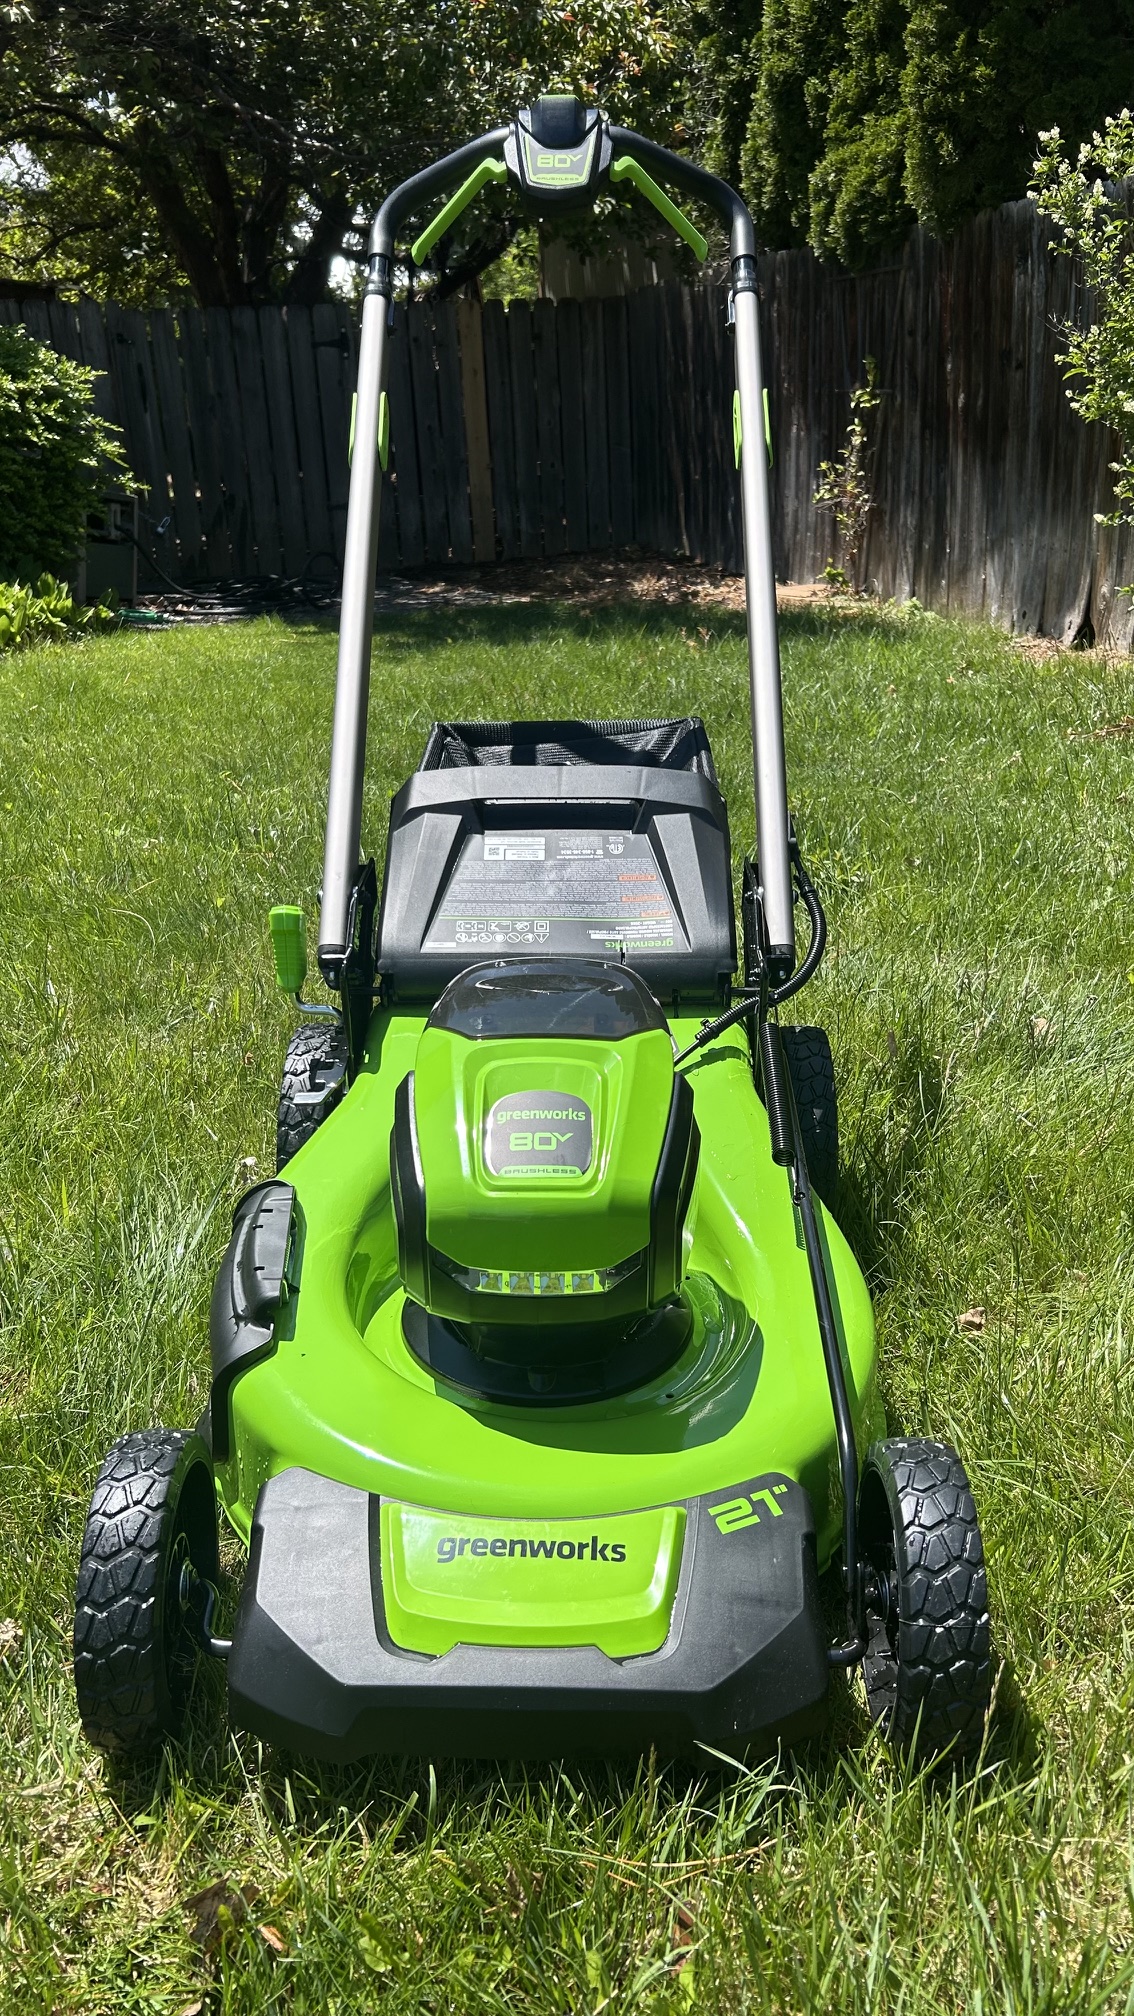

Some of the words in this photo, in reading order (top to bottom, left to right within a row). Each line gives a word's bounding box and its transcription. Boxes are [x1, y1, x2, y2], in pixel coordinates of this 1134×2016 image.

[604, 937, 674, 950] greenwoks
[497, 1108, 586, 1125] greenworks
[509, 1132, 574, 1151] 80V
[707, 1484, 788, 1535] 21"
[437, 1535, 626, 1564] greenworks
